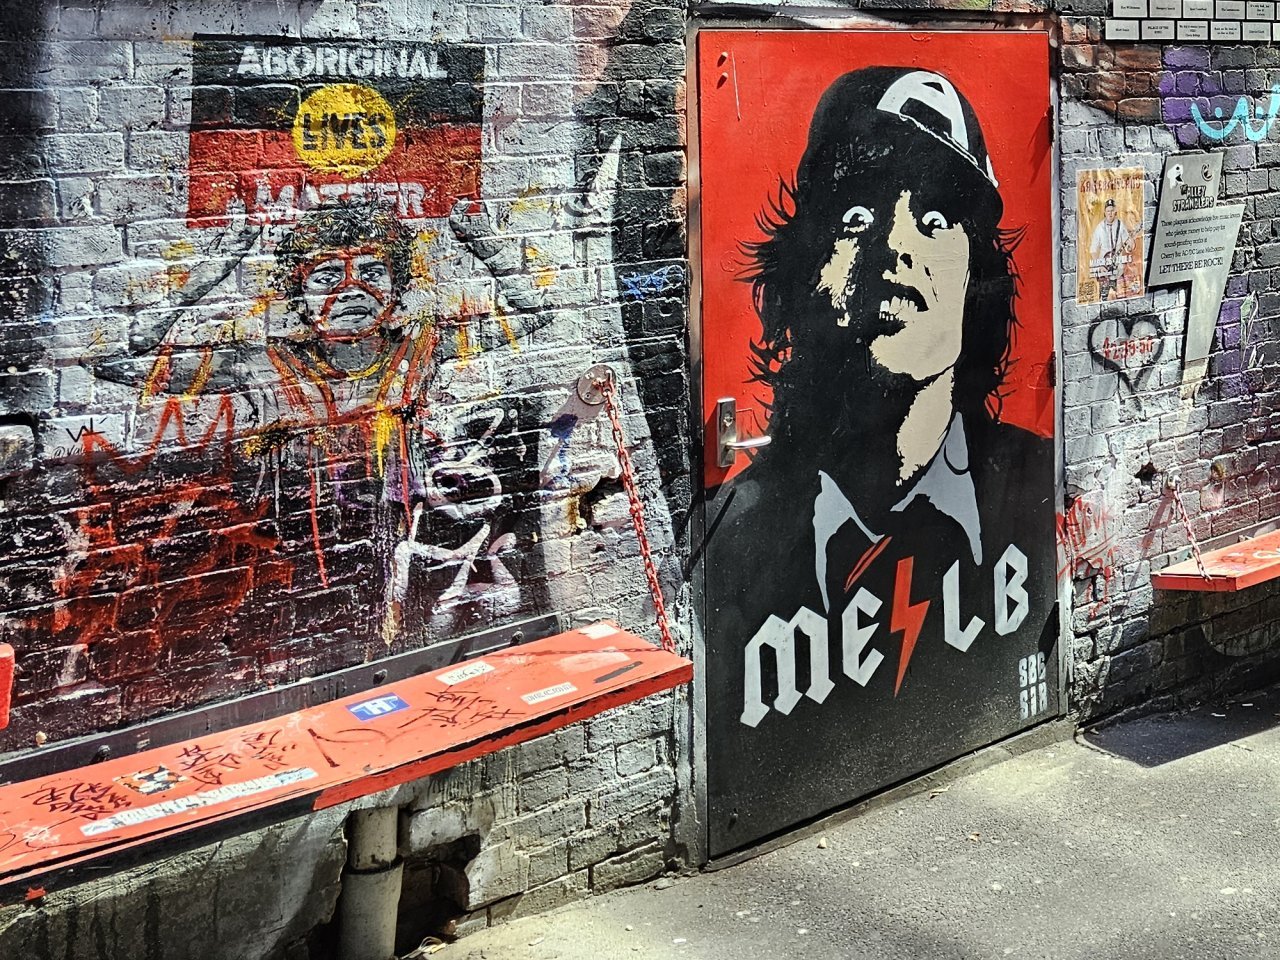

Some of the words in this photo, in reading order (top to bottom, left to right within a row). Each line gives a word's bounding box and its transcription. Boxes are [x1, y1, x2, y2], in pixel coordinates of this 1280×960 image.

[236, 45, 449, 79] ABORIGINAL
[302, 112, 387, 151] LIVES
[1186, 185, 1206, 198] ALLEY
[1173, 196, 1214, 212] STRANGLERS
[1159, 263, 1172, 274] LET
[1172, 260, 1194, 272] THERE
[1194, 259, 1203, 269] BE
[1203, 256, 1224, 267] ROCK!
